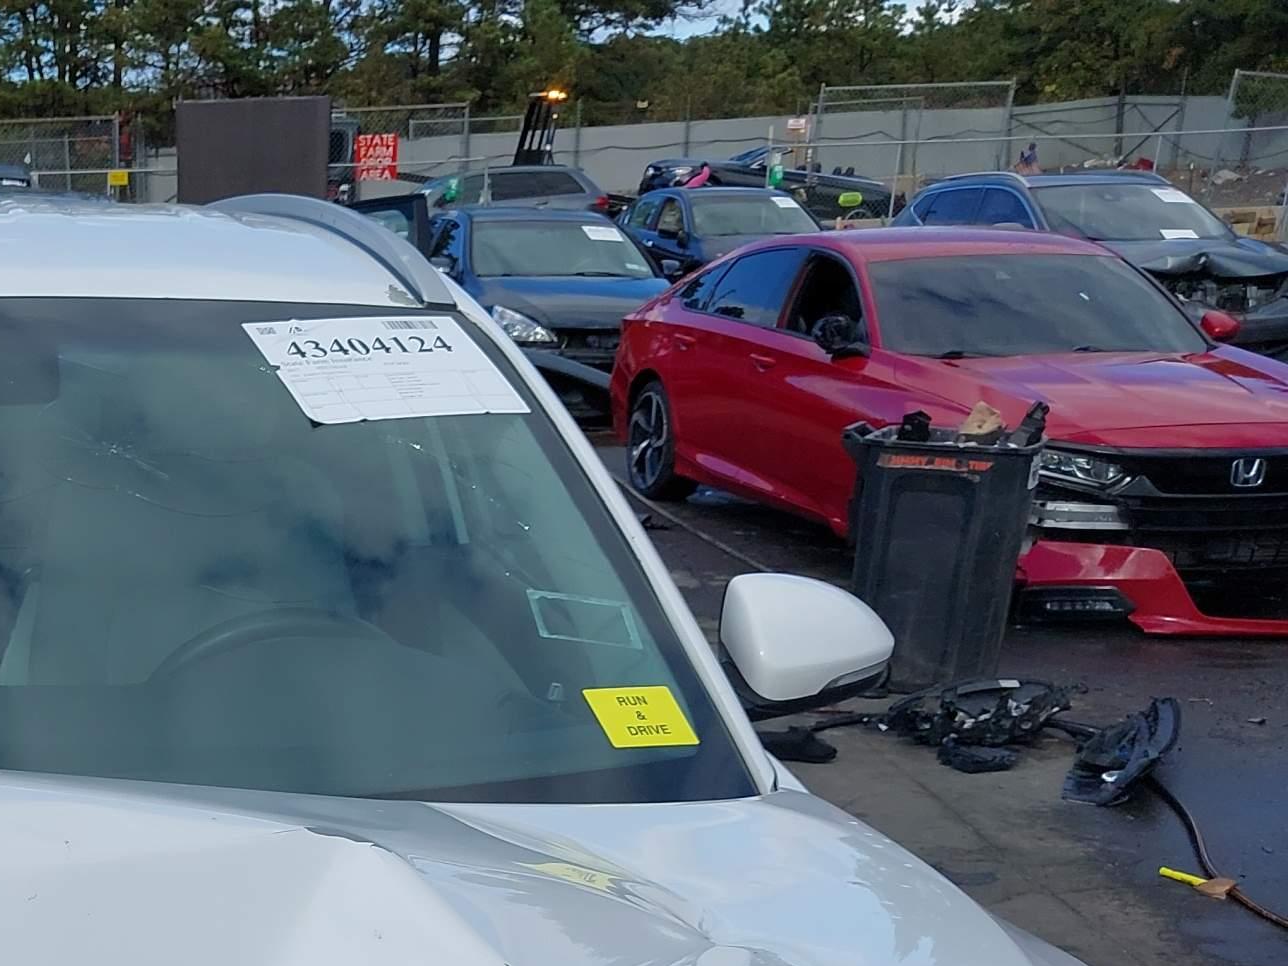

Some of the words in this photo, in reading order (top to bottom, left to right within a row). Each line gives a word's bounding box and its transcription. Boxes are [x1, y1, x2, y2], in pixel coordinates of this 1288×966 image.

[359, 134, 395, 146] STATE
[360, 146, 394, 158] FARM
[360, 169, 392, 180] AREA
[287, 336, 454, 358] 43404124
[616, 695, 648, 706] RUN
[636, 711, 647, 720] &
[626, 725, 672, 736] DRIVE
